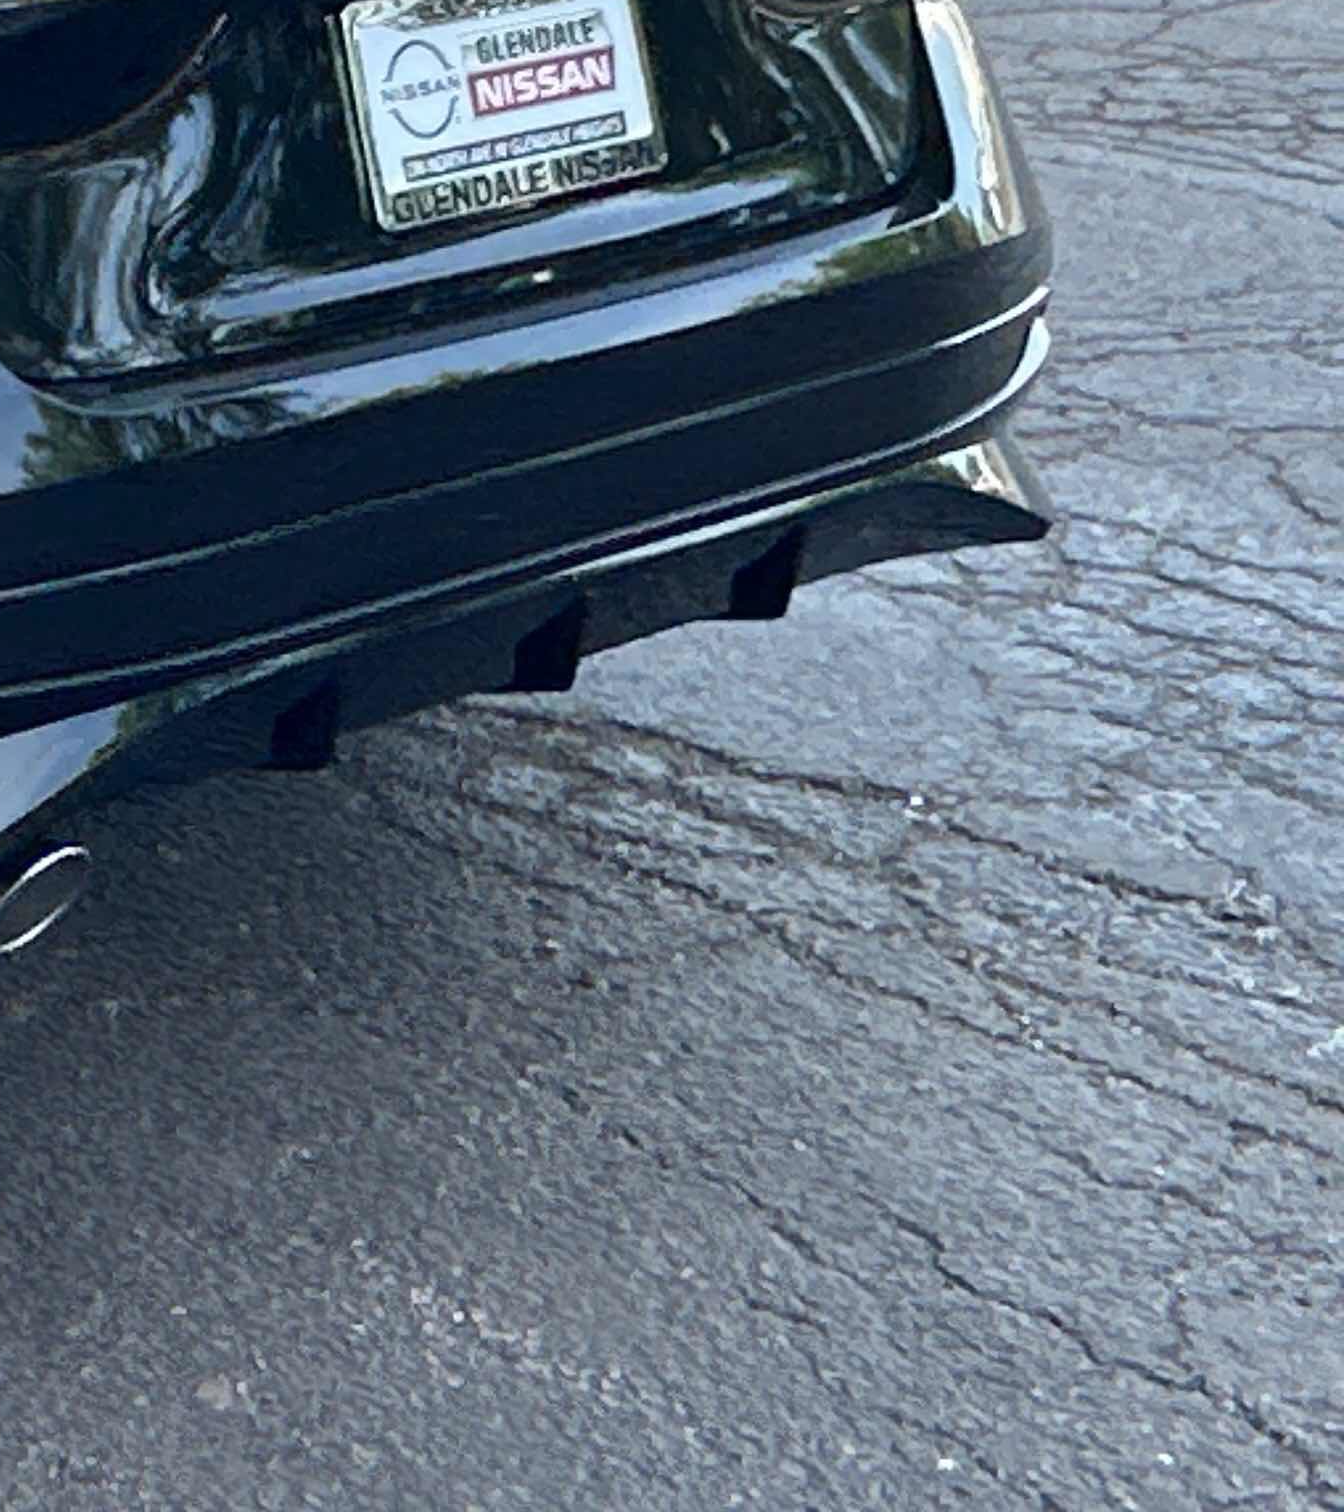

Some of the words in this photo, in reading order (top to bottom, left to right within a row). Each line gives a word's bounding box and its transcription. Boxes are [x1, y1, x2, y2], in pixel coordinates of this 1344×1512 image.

[475, 17, 597, 65] GLENDALE
[379, 73, 461, 105] NISSAN
[472, 52, 611, 112] NISSAN
[392, 161, 550, 224] GLENDALE
[551, 140, 657, 187] NISSAN
